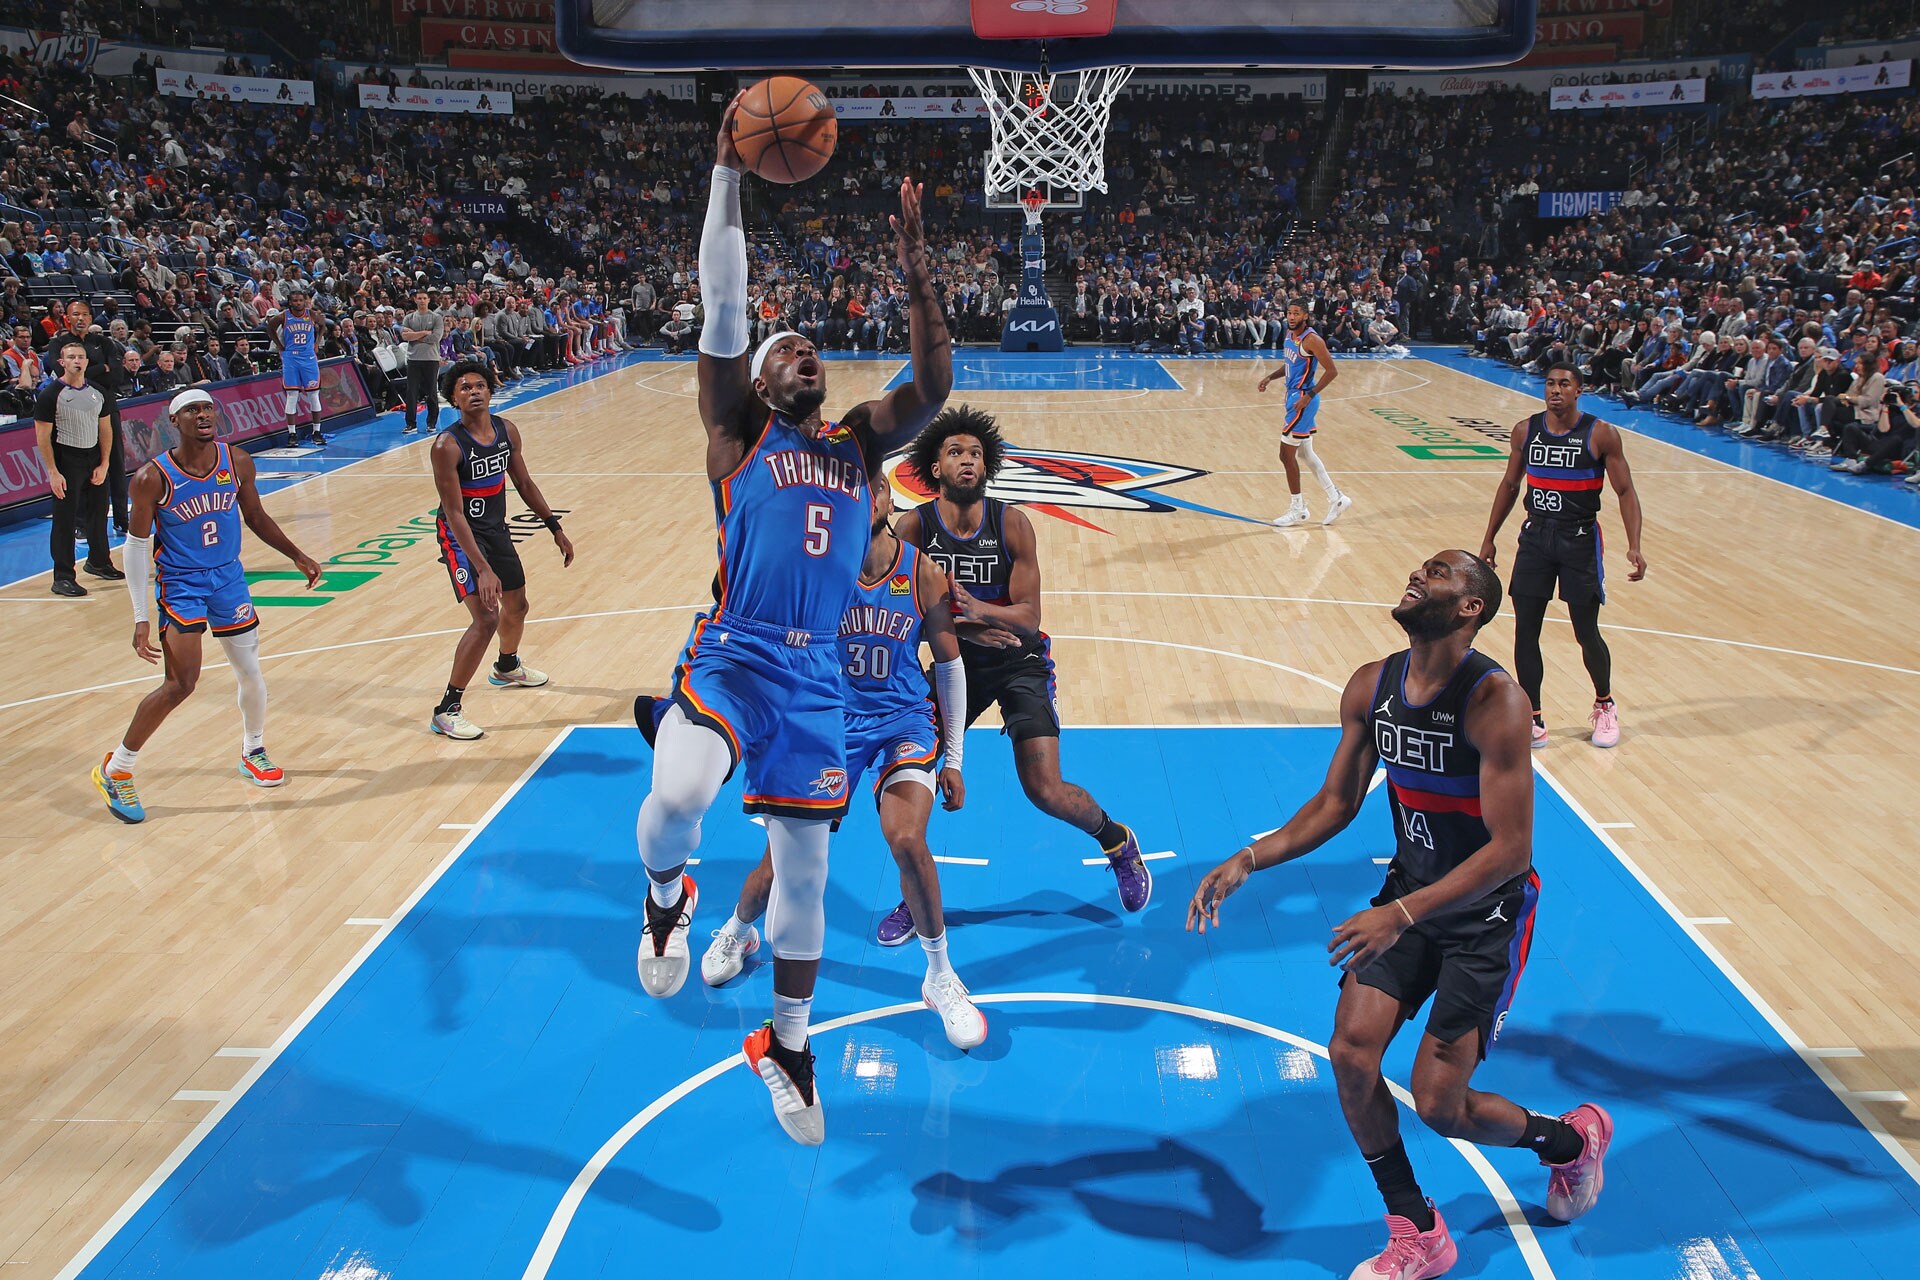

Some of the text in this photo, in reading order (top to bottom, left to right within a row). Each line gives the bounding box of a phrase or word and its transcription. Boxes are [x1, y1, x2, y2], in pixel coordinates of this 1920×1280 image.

[401, 0, 556, 17] RIVERWI
[460, 25, 552, 46] CASIN
[1536, 20, 1604, 41] SINO
[670, 84, 694, 97] 119
[1127, 84, 1252, 98] THUNDER
[1302, 83, 1324, 96] 101
[1440, 77, 1477, 92] Bally
[463, 203, 506, 214] ULTRA
[1020, 296, 1046, 305] Health
[294, 333, 307, 344] 22
[227, 391, 313, 433] BRAU
[471, 449, 511, 480] DET
[1528, 444, 1582, 468] DET
[764, 450, 862, 502] THUNDER
[171, 492, 237, 522] THUNDER
[469, 497, 486, 518] 9
[1532, 488, 1563, 512] 23
[201, 520, 219, 548] 2
[803, 501, 833, 558] 5
[978, 538, 998, 548] UWM
[837, 605, 915, 642] HUNDER
[784, 630, 812, 648] OKC
[846, 643, 891, 681] 30
[1431, 710, 1455, 724] UWM
[1375, 718, 1454, 774] DET
